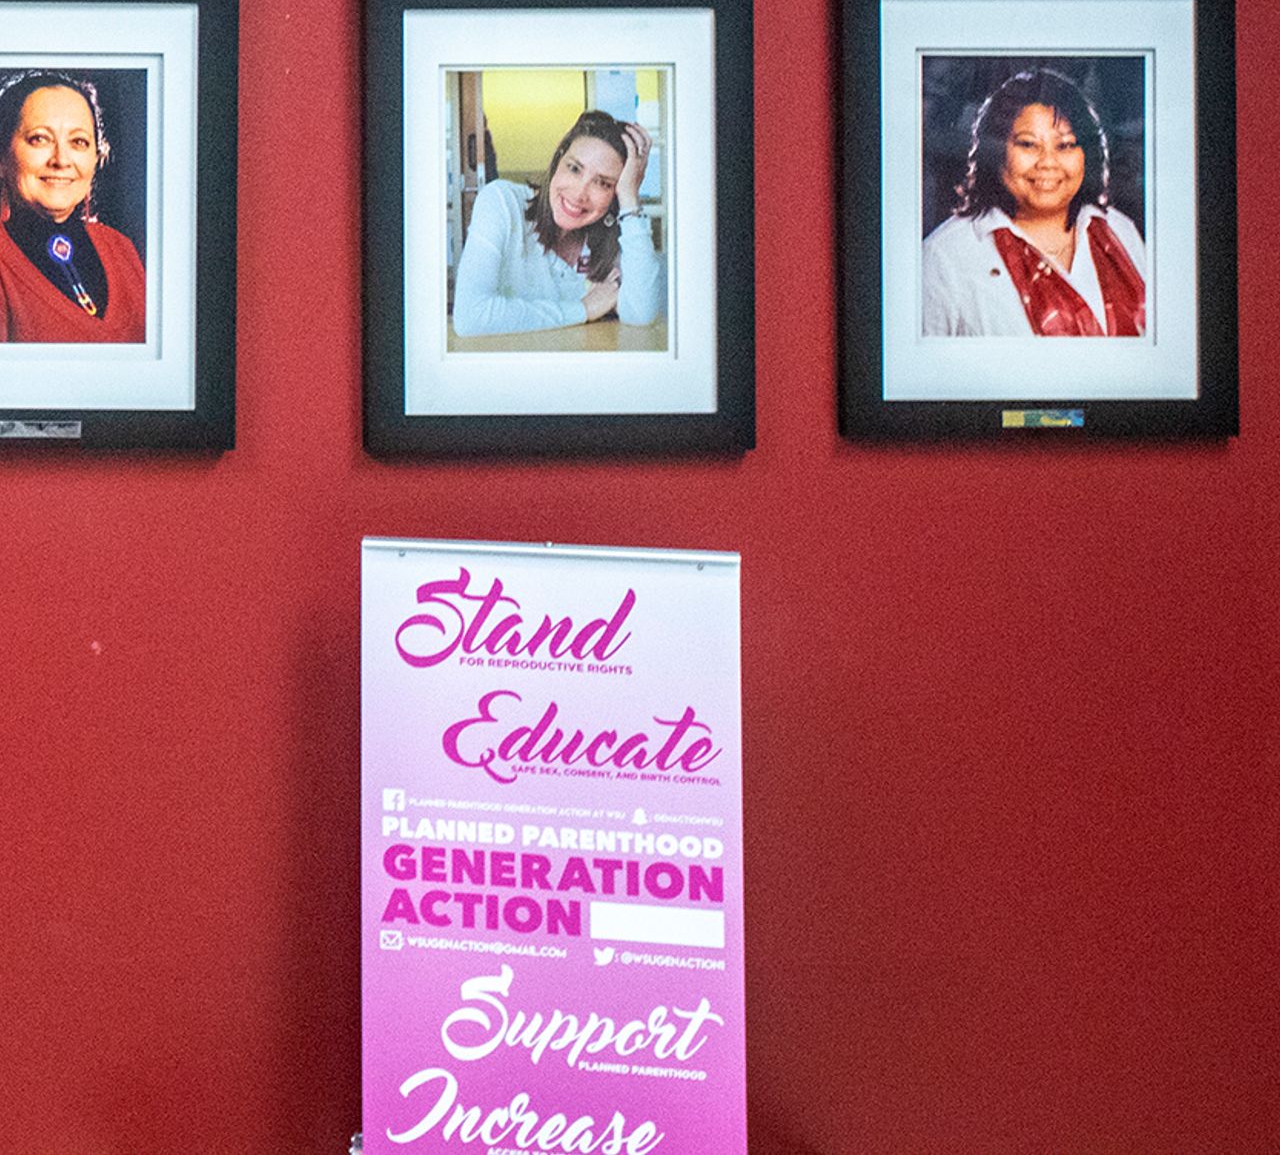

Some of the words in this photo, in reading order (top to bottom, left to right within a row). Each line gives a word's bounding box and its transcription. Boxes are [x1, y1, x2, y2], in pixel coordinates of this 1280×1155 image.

[395, 566, 637, 668] Stand
[459, 656, 485, 668] FOR
[487, 658, 584, 673] REPRODUCTIVE
[588, 663, 633, 676] RIGHTS
[442, 689, 723, 785] Educate
[511, 764, 537, 775] SAFE
[540, 766, 561, 777] SEX,
[563, 768, 614, 780] CONSENT,
[616, 771, 638, 781] AND
[640, 773, 671, 783] BIRTH
[673, 775, 722, 787] CONTROL
[382, 816, 514, 844] PLANNED
[521, 825, 724, 858] PARENTHOOD
[383, 843, 724, 902] GENERATION
[381, 888, 581, 936] ACTION
[441, 963, 724, 1067] Support
[578, 1060, 630, 1075] PLANNED
[632, 1065, 707, 1081] PARENTHOOD
[387, 1067, 665, 1155] Increase
